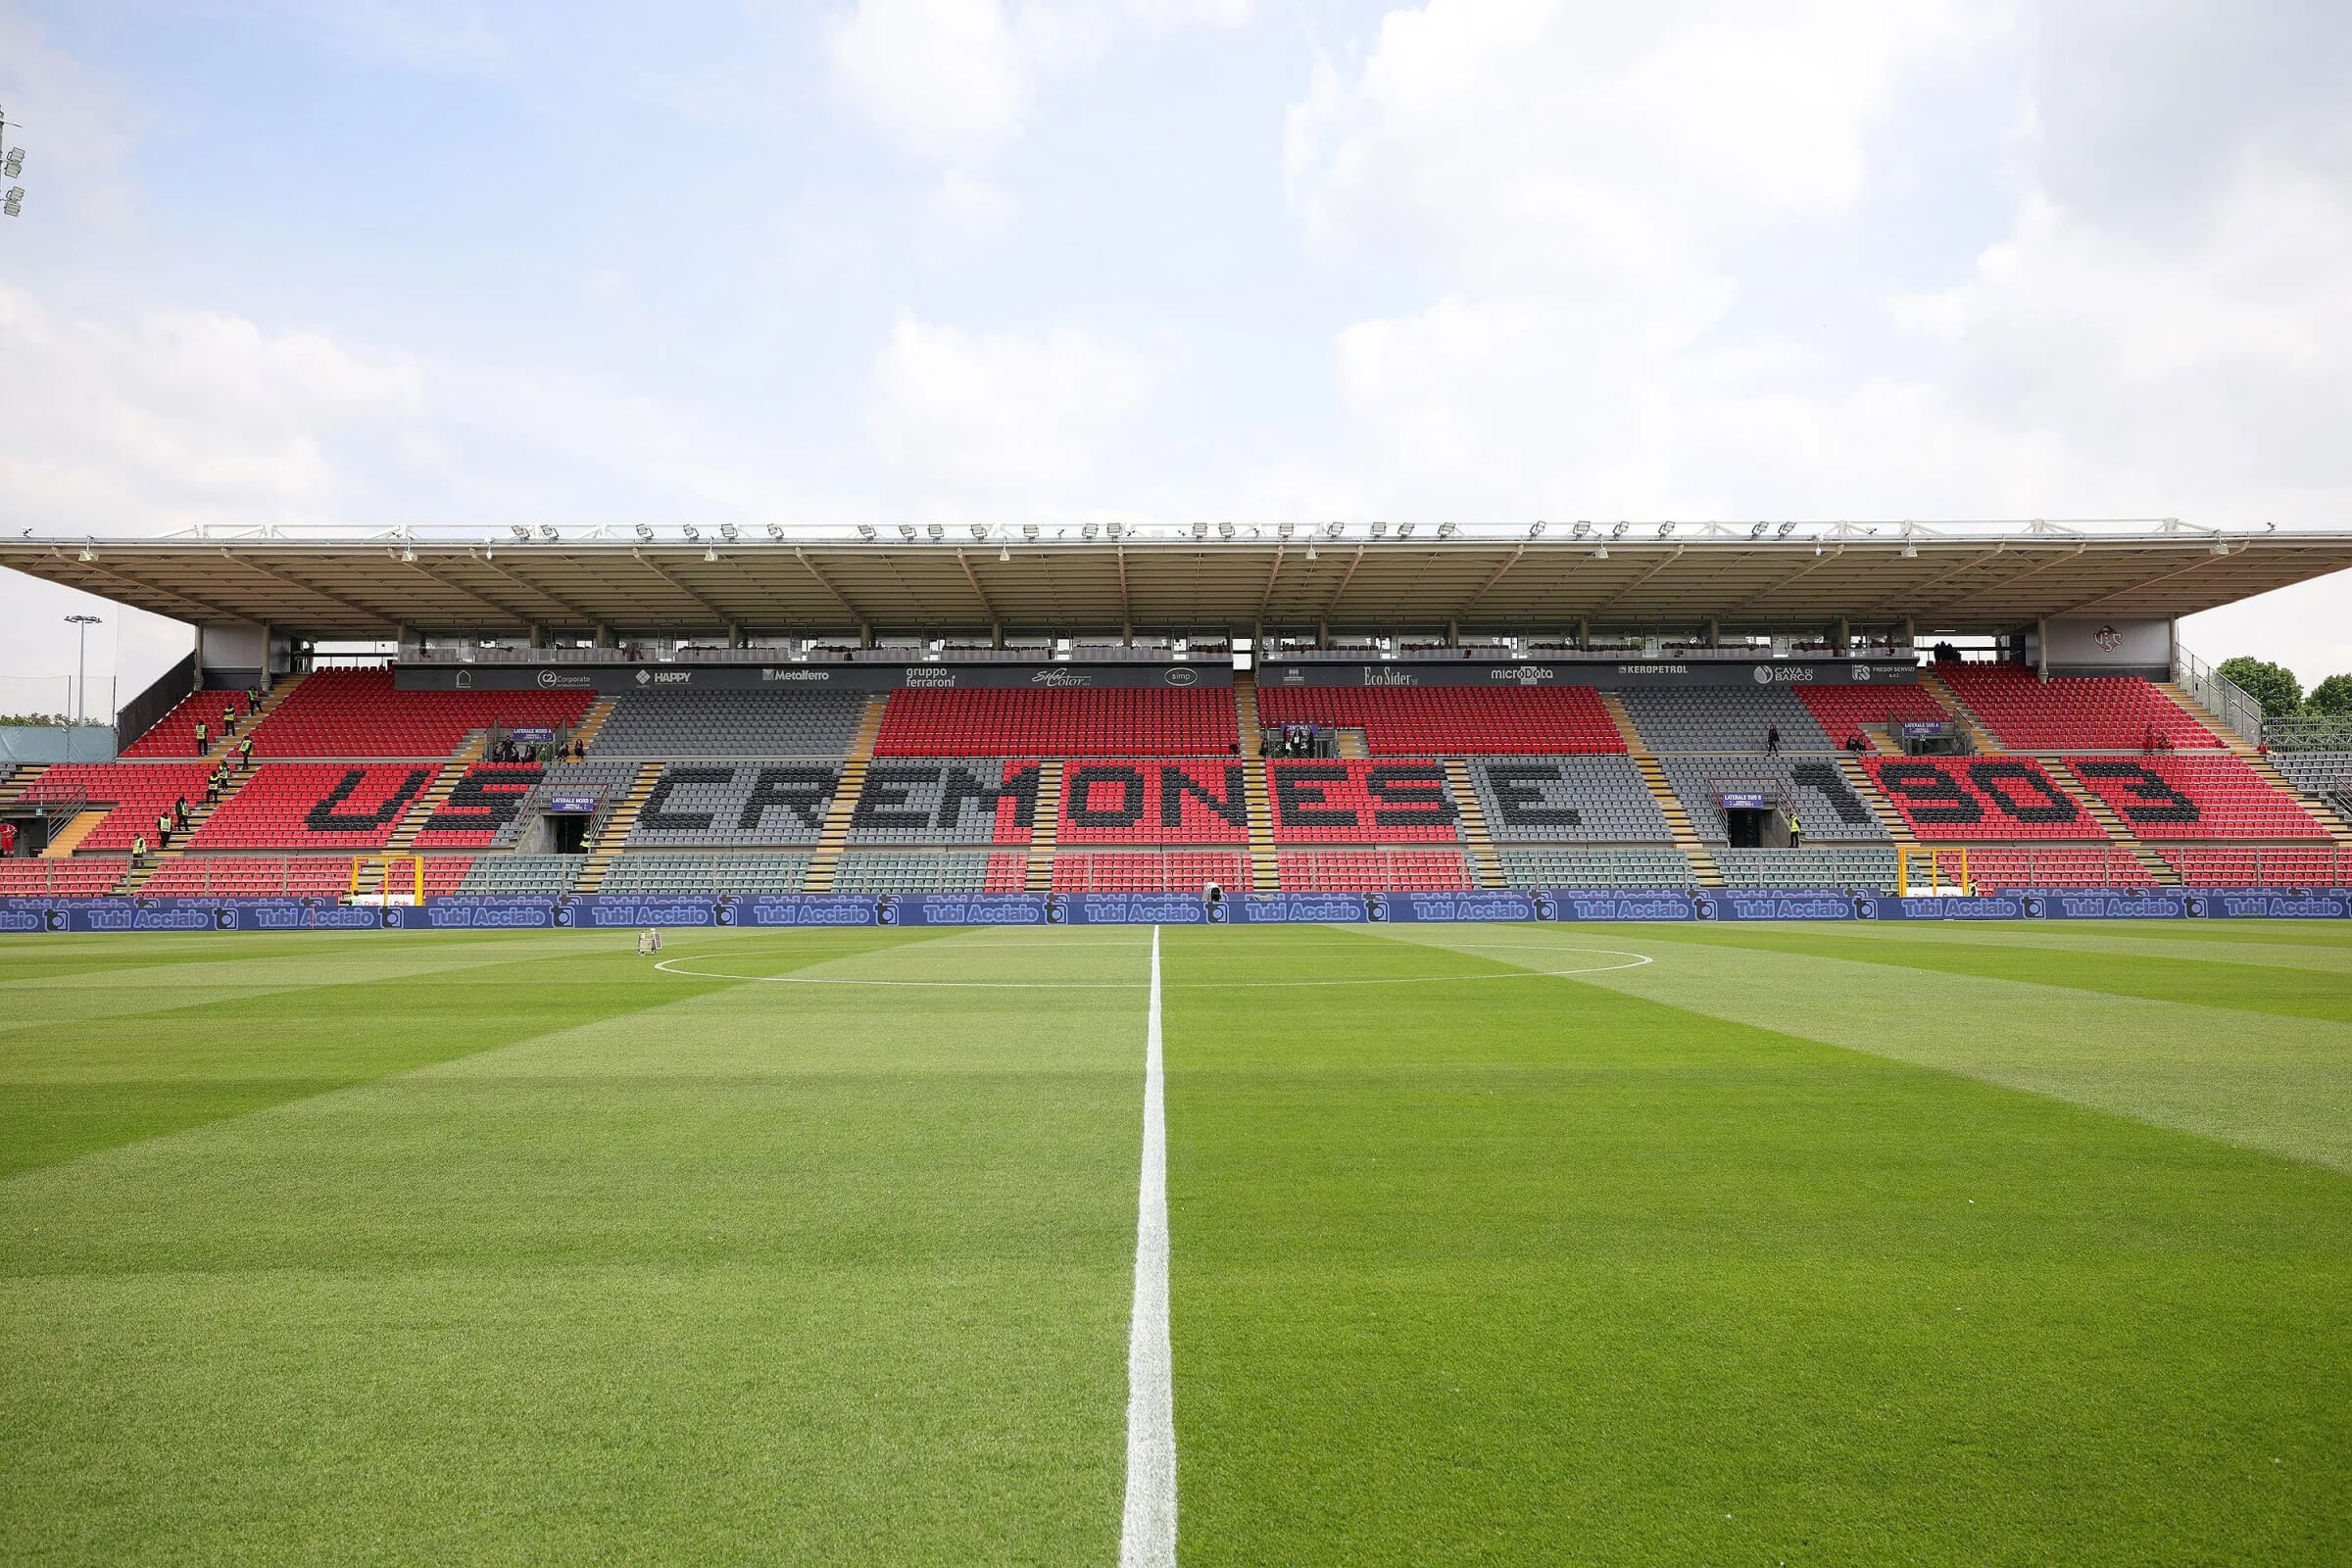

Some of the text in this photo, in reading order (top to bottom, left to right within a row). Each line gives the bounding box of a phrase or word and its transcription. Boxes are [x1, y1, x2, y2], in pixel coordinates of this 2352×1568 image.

[654, 672, 692, 682] HAPPY
[774, 670, 830, 680] Metalferro
[906, 667, 948, 678] gruppo
[1491, 666, 1553, 679] microData
[1628, 665, 1689, 674] KEROPETROL
[557, 675, 591, 684] Corporate
[906, 674, 956, 687] ferraroni
[636, 765, 1583, 829] CREMONESE
[1789, 762, 2201, 824] 1903
[591, 906, 709, 925] Tubi Acciaio
[754, 905, 869, 923] Tubi Acciaio
[923, 904, 1039, 923] Tubi Acciaio
[1084, 903, 1200, 922] Tubi Acciaio
[1245, 902, 1360, 921] Tubi Acciaio
[1413, 901, 1529, 919] Tubi Acciaio
[1574, 901, 1689, 918] Tubi Acciaio
[1734, 900, 1849, 918] Tubi Acciaio
[1901, 899, 2017, 917] Tubi Acciaio
[2062, 898, 2179, 916] Tubi Acciaio
[2224, 898, 2342, 916] Tubi Acciaio
[88, 909, 208, 928] Tubi Acciaio
[255, 908, 374, 926] Tubi Acciaio
[428, 907, 546, 926] Tubi Acciaio
